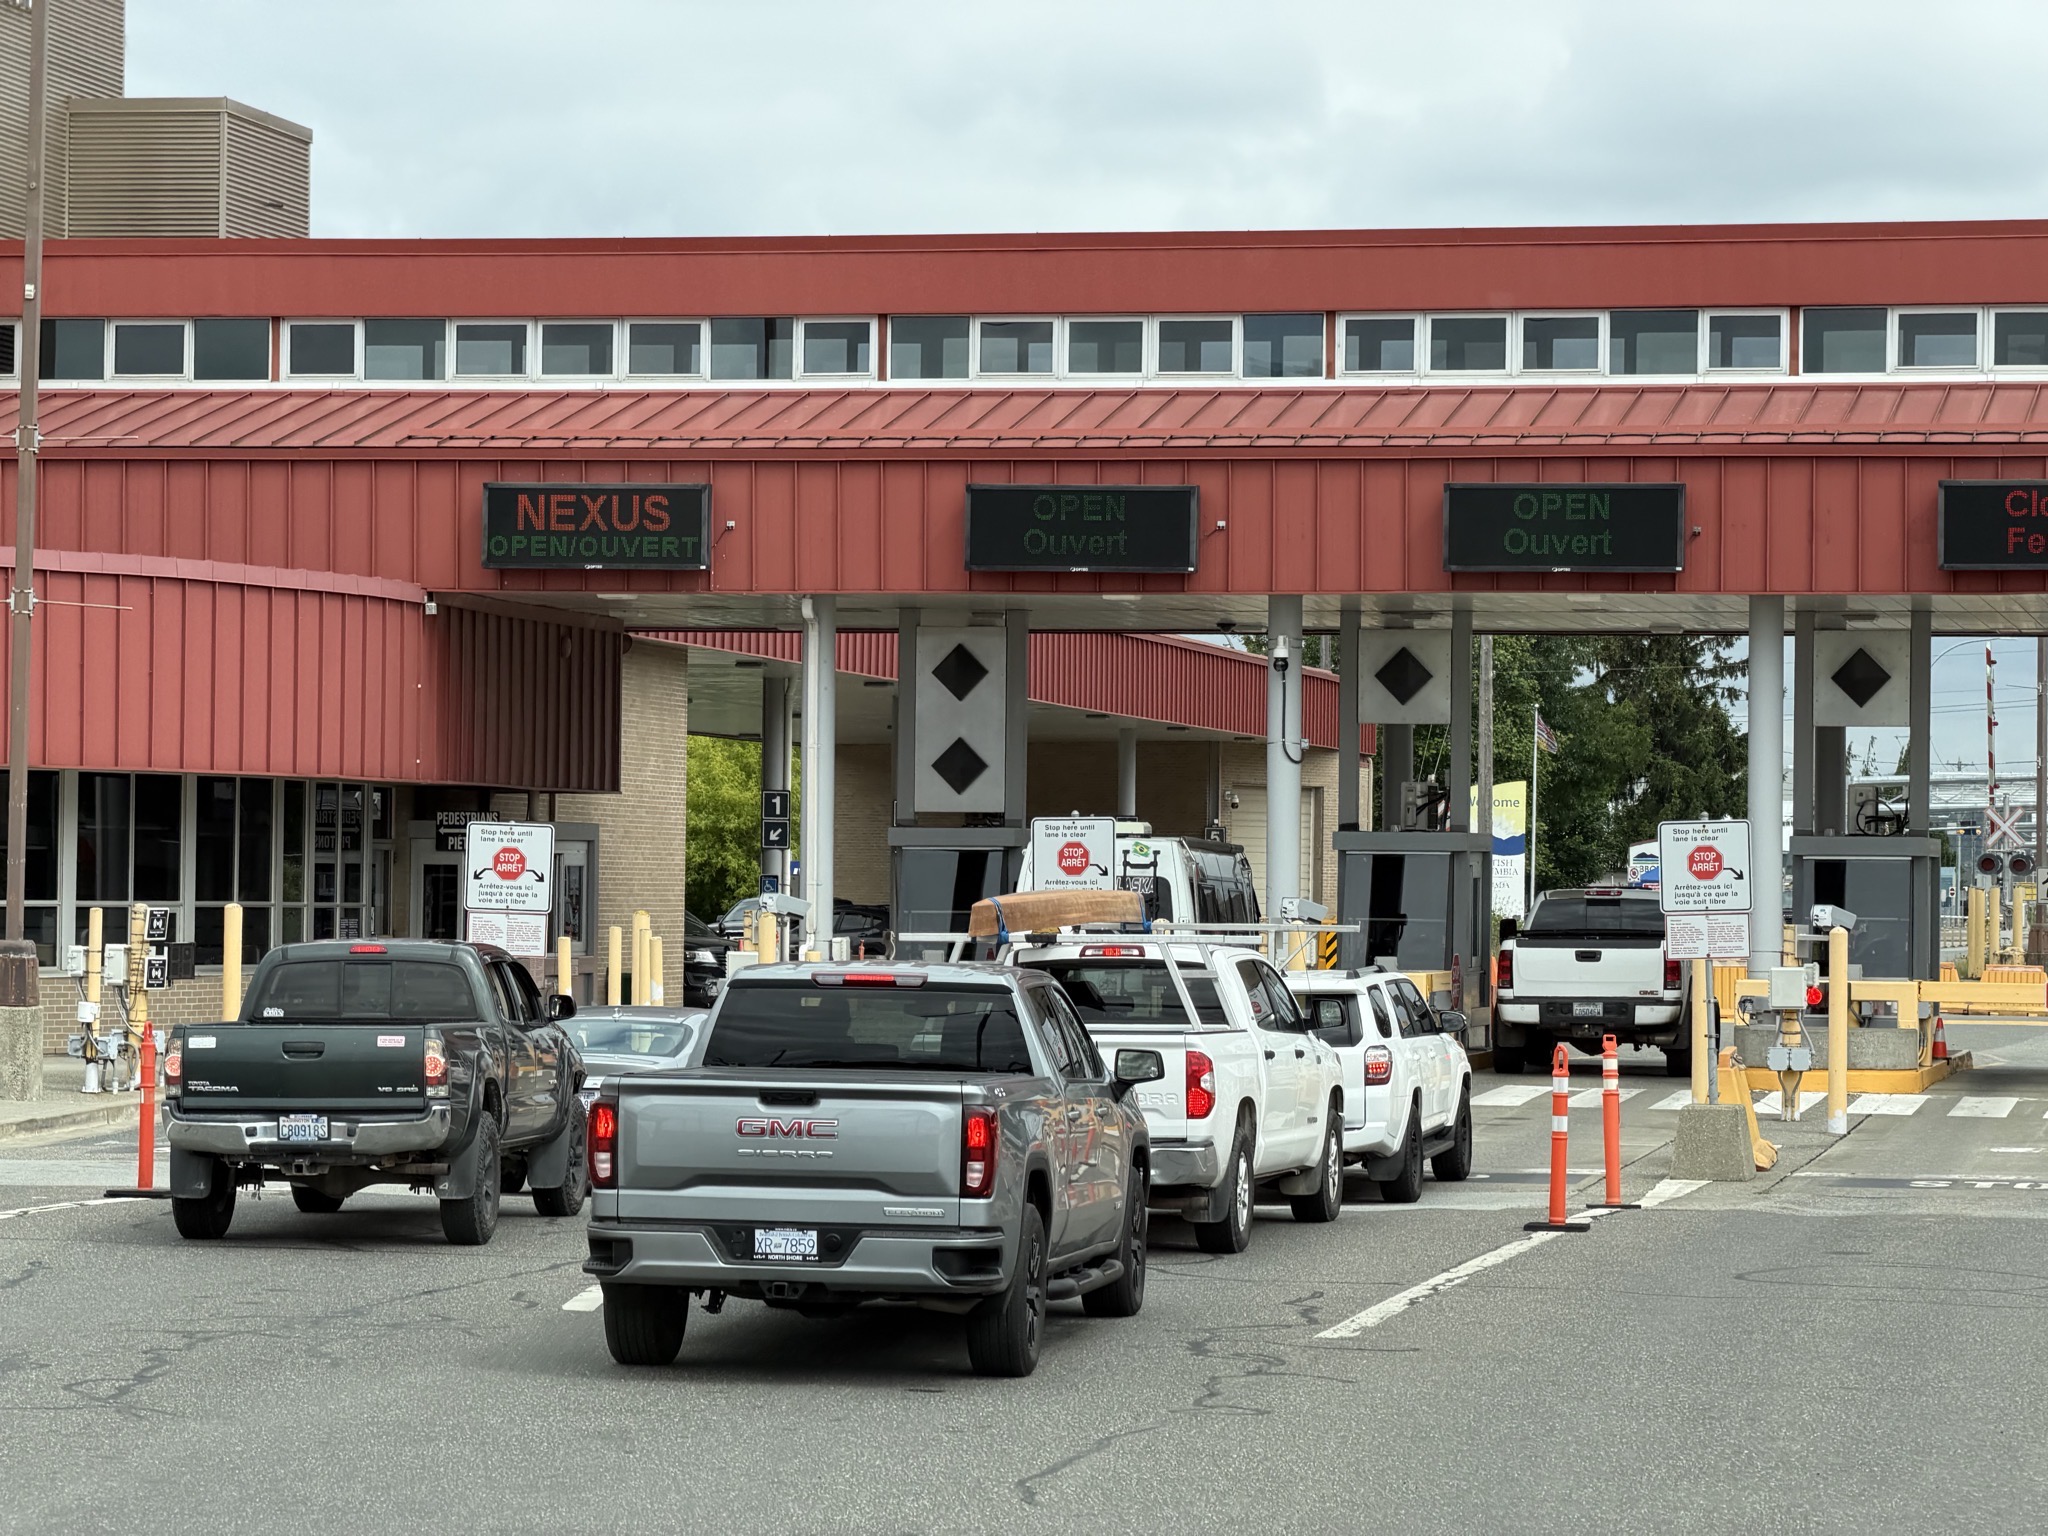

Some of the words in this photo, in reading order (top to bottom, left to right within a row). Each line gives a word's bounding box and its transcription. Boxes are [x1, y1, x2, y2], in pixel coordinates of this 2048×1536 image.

[516, 494, 671, 532] NEXUS
[1033, 494, 1126, 521] OPEN
[1514, 494, 1609, 520] OPEN
[489, 536, 698, 558] OPEN/OUVERT
[1024, 528, 1128, 555] Ouvert
[1503, 528, 1612, 555] Ouvert
[2007, 527, 2046, 554] Fe
[772, 796, 780, 815] 1
[437, 812, 498, 825] PEDESTRIANS
[480, 828, 497, 836] Stop
[1210, 830, 1220, 842] 5
[500, 852, 520, 862] STOP
[1064, 848, 1084, 856] STOP
[1694, 852, 1716, 861] STOP
[496, 862, 522, 872] ARRÊT
[1061, 858, 1086, 867] ARRÊT
[1692, 862, 1720, 872] ARRÊT
[1494, 868, 1518, 876] MBIA
[1116, 876, 1154, 894] LASKA
[1674, 890, 1700, 898] jusqu'à
[281, 1124, 326, 1137] C80918S
[737, 1118, 838, 1140] GMC
[738, 1149, 833, 1158] SIERRA
[756, 1238, 772, 1253] XR
[781, 1238, 816, 1254] 7859
